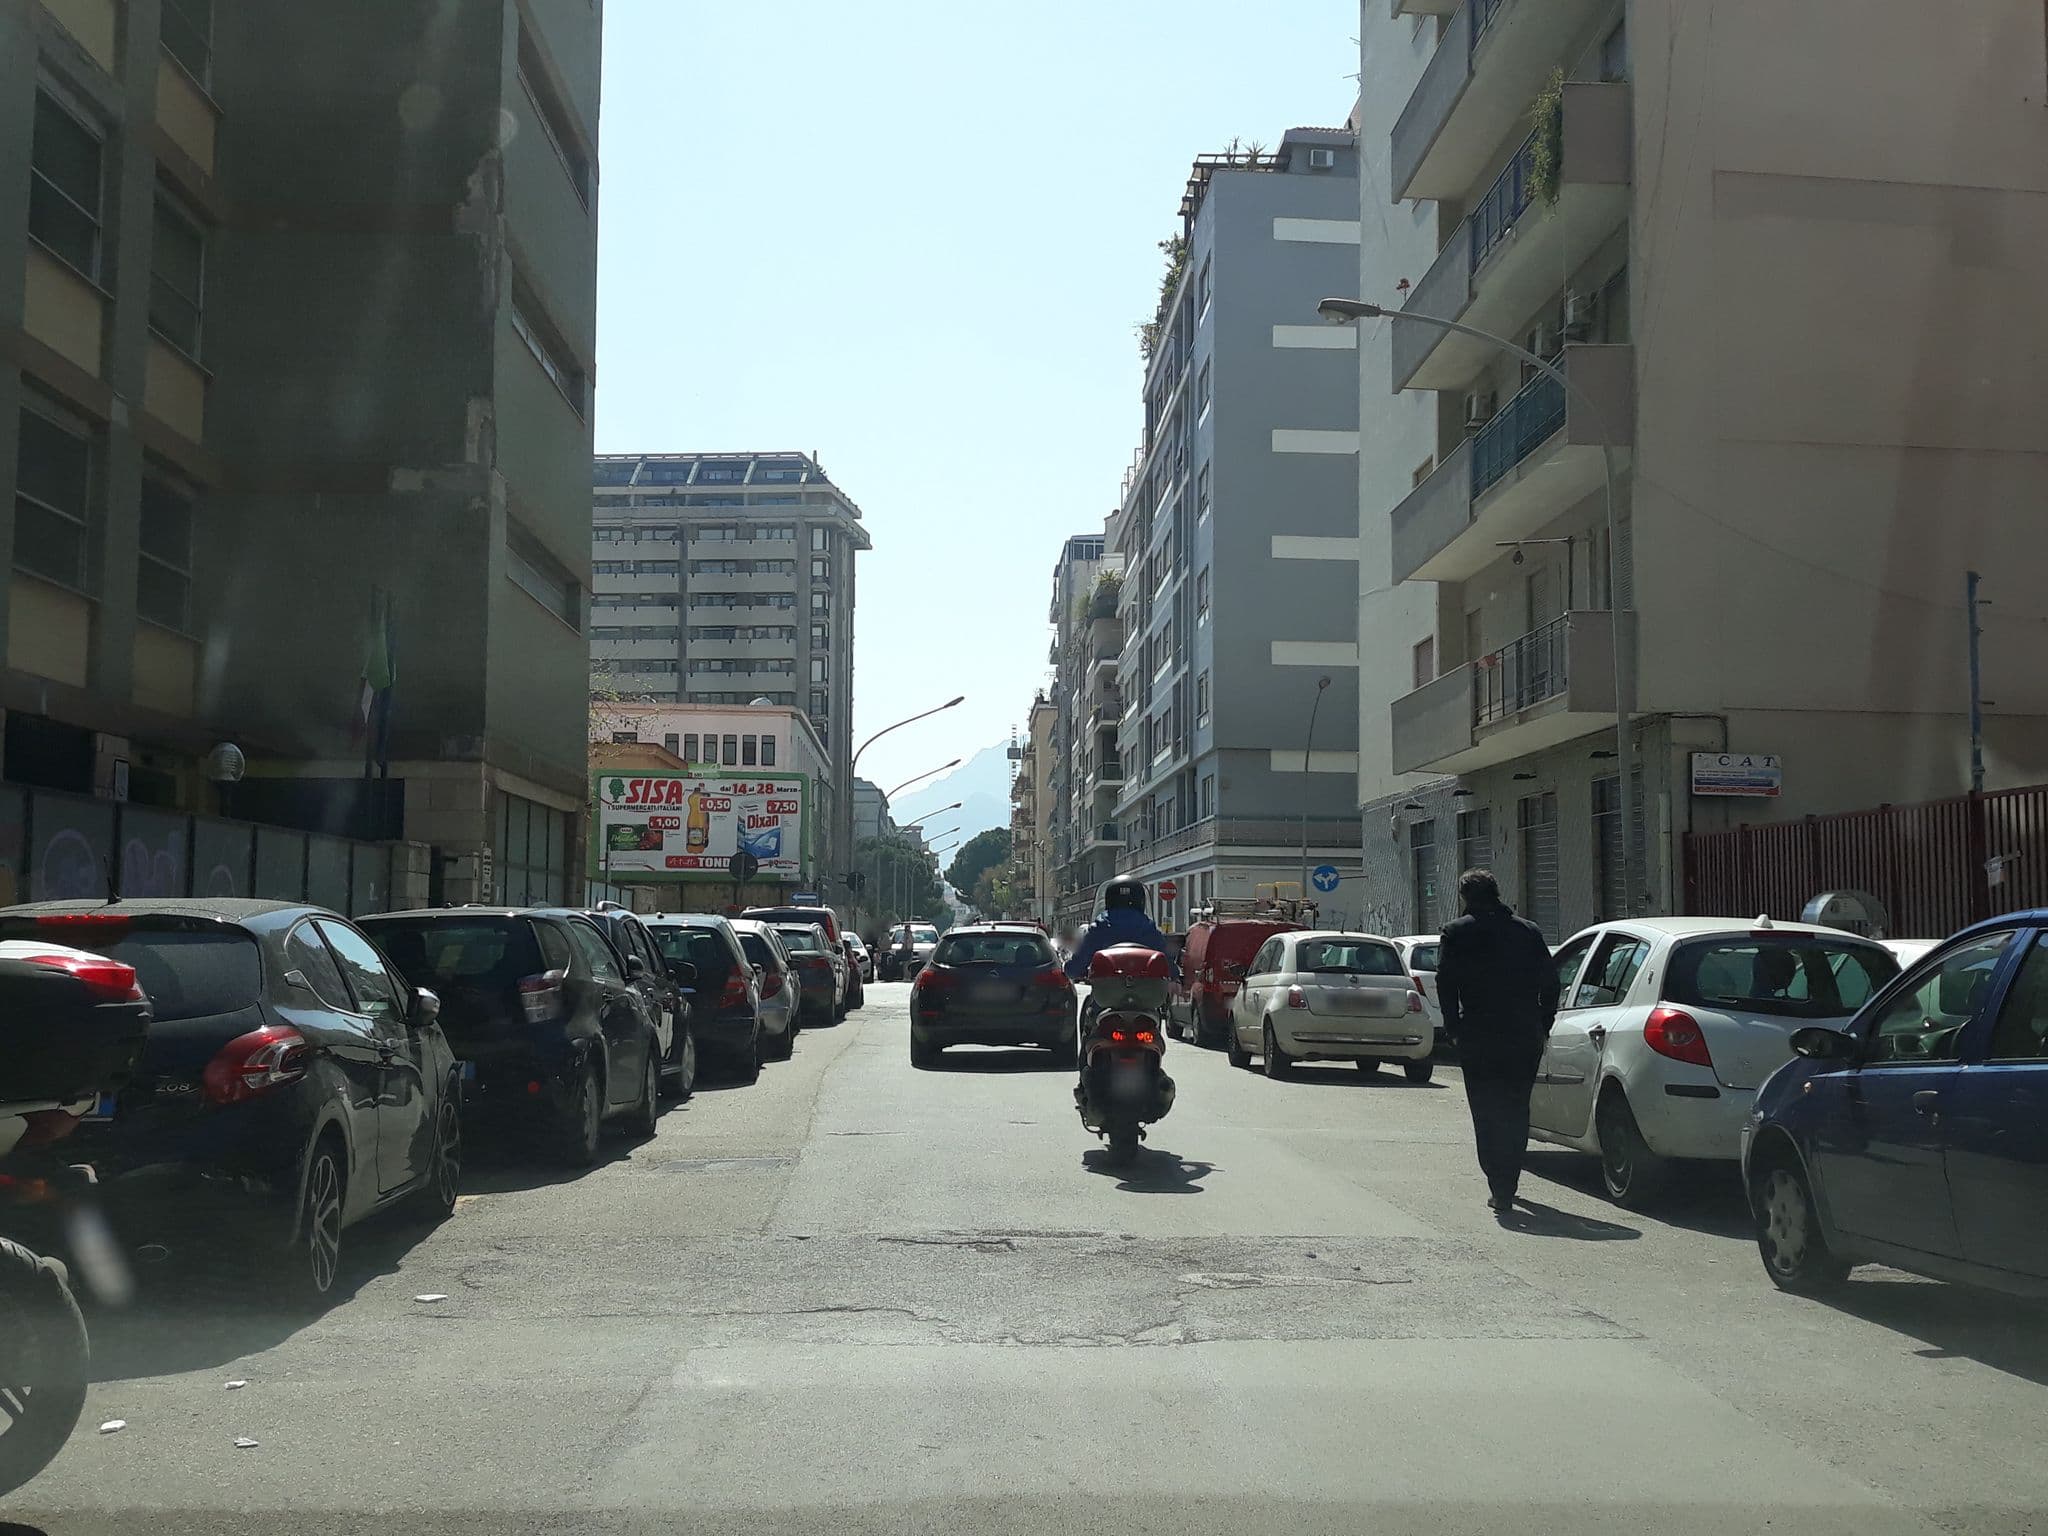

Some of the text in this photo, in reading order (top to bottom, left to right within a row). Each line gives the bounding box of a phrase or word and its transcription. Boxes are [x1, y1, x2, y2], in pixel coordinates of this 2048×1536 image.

[625, 779, 683, 804] SISA
[719, 784, 732, 793] dal
[732, 783, 748, 794] 14
[748, 785, 755, 793] al
[756, 783, 774, 794] 28
[706, 800, 730, 810] 0,50
[773, 802, 797, 812] 7,50
[656, 818, 679, 828] 1,00
[746, 814, 779, 829] Dixan
[697, 857, 731, 868] TOND
